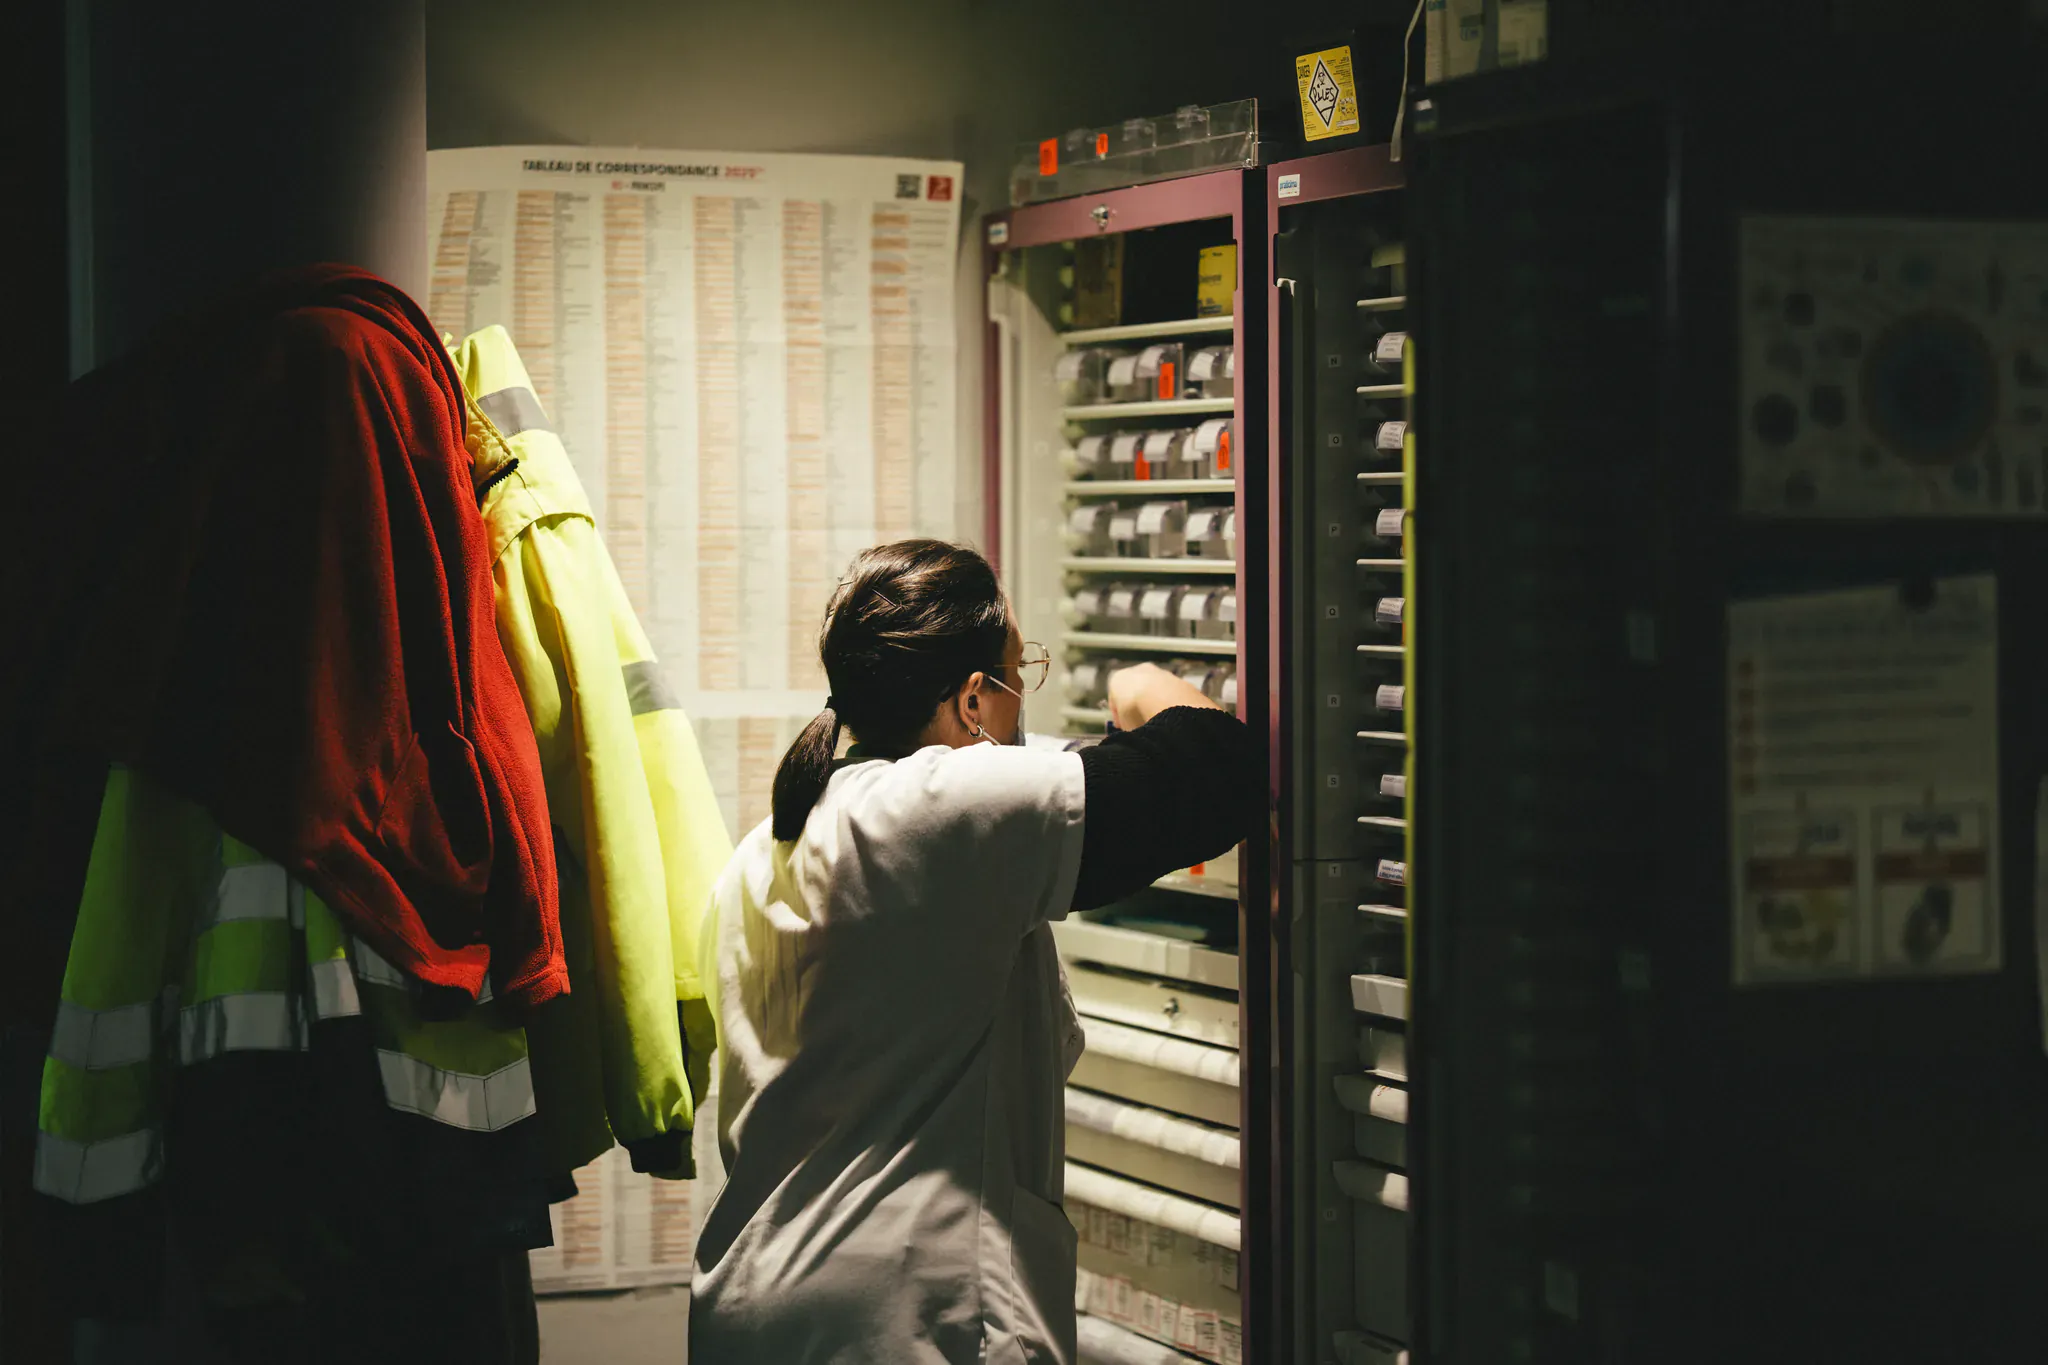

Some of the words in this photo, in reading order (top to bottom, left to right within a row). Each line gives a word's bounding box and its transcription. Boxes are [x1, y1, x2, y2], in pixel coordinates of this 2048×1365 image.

[1312, 85, 1335, 104] PILES
[522, 159, 572, 173] TABLEAU
[576, 161, 592, 174] DE
[596, 162, 720, 177] CORRESPONDANCE
[1330, 357, 1338, 365] N
[1331, 526, 1338, 534] P
[1329, 607, 1337, 616] Q
[1330, 696, 1338, 705] R
[1330, 777, 1337, 785] S
